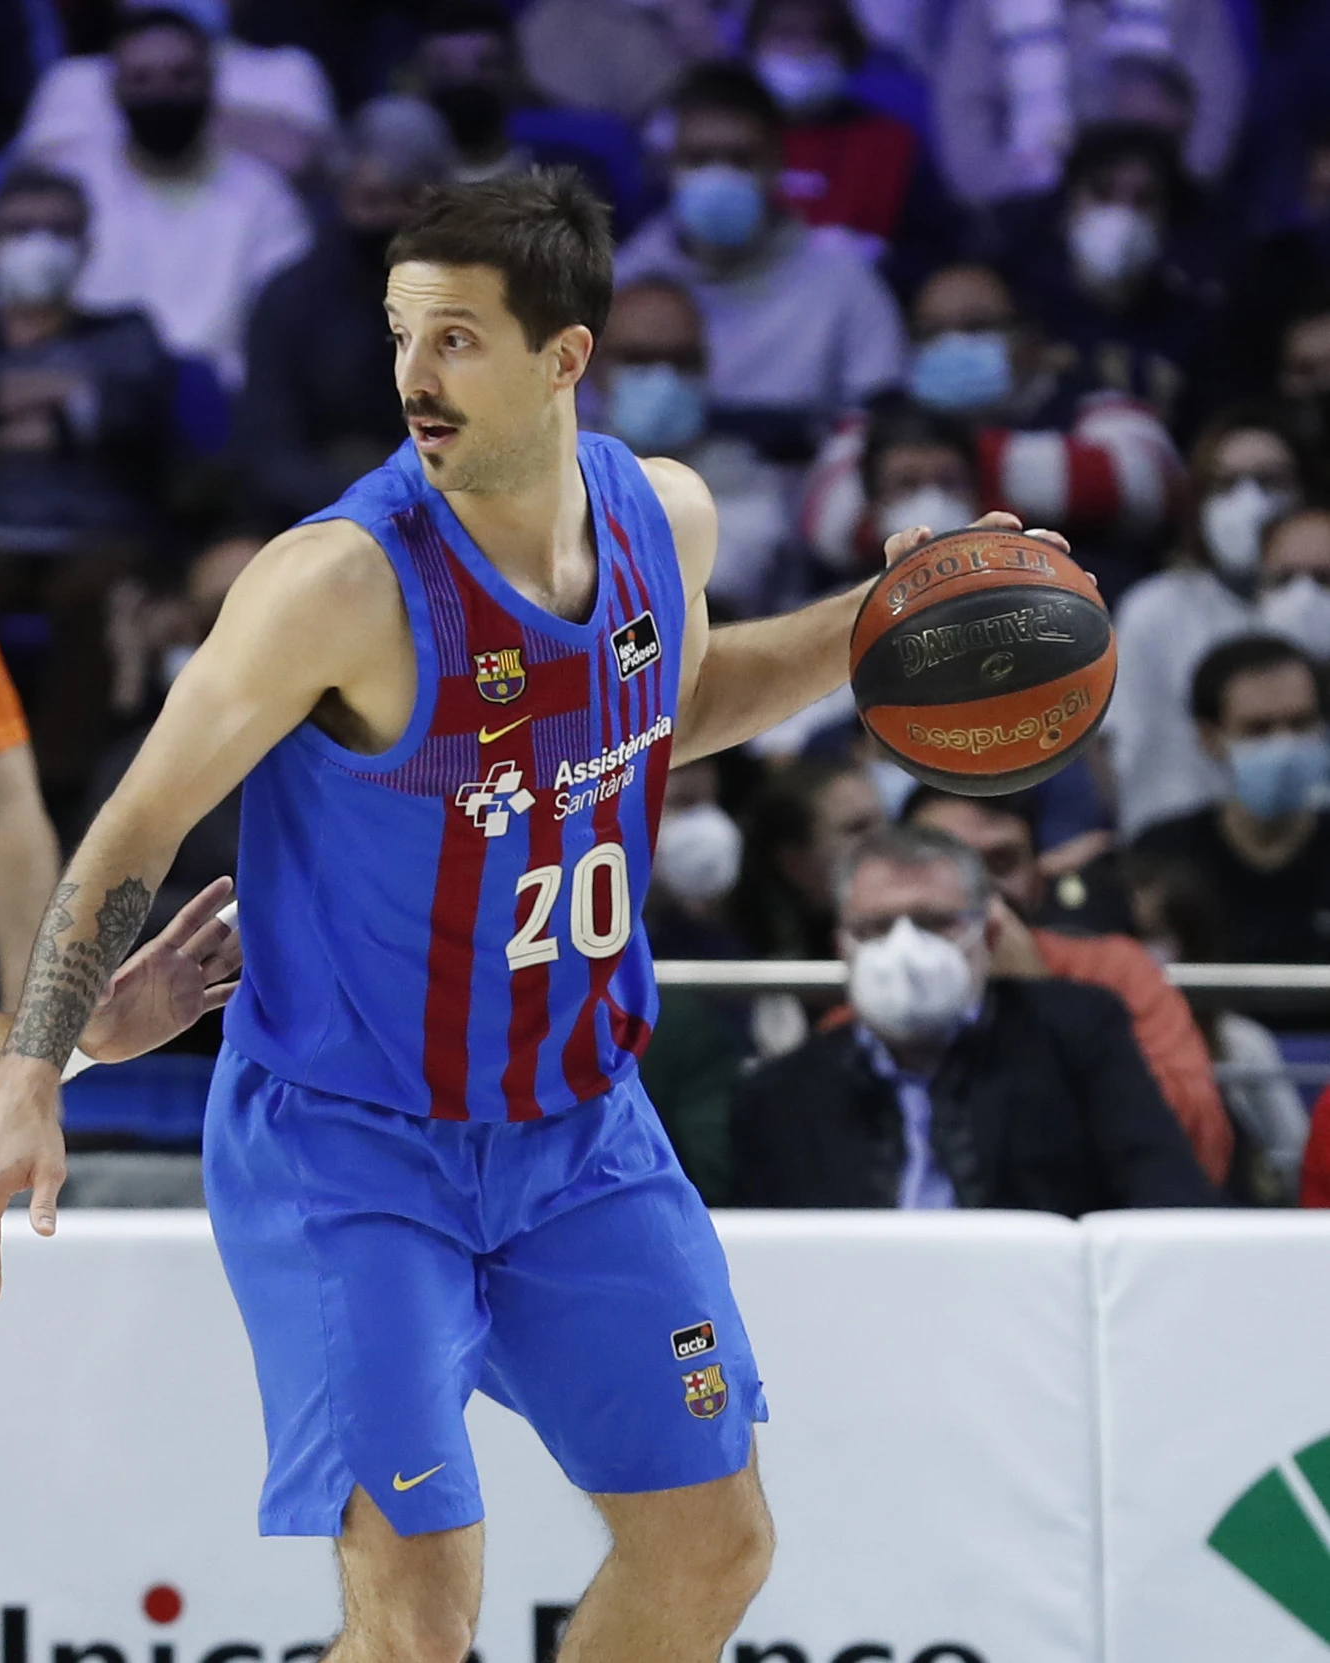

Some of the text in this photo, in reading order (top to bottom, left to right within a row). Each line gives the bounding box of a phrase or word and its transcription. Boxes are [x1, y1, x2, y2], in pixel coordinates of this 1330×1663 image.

[887, 549, 1056, 609] TF-1000
[622, 641, 657, 672] endesa
[907, 686, 1092, 754] liga endesa
[554, 715, 672, 791] Assistència
[554, 763, 635, 820] Sanitària
[505, 842, 631, 971] 20
[678, 1336, 707, 1354] acb
